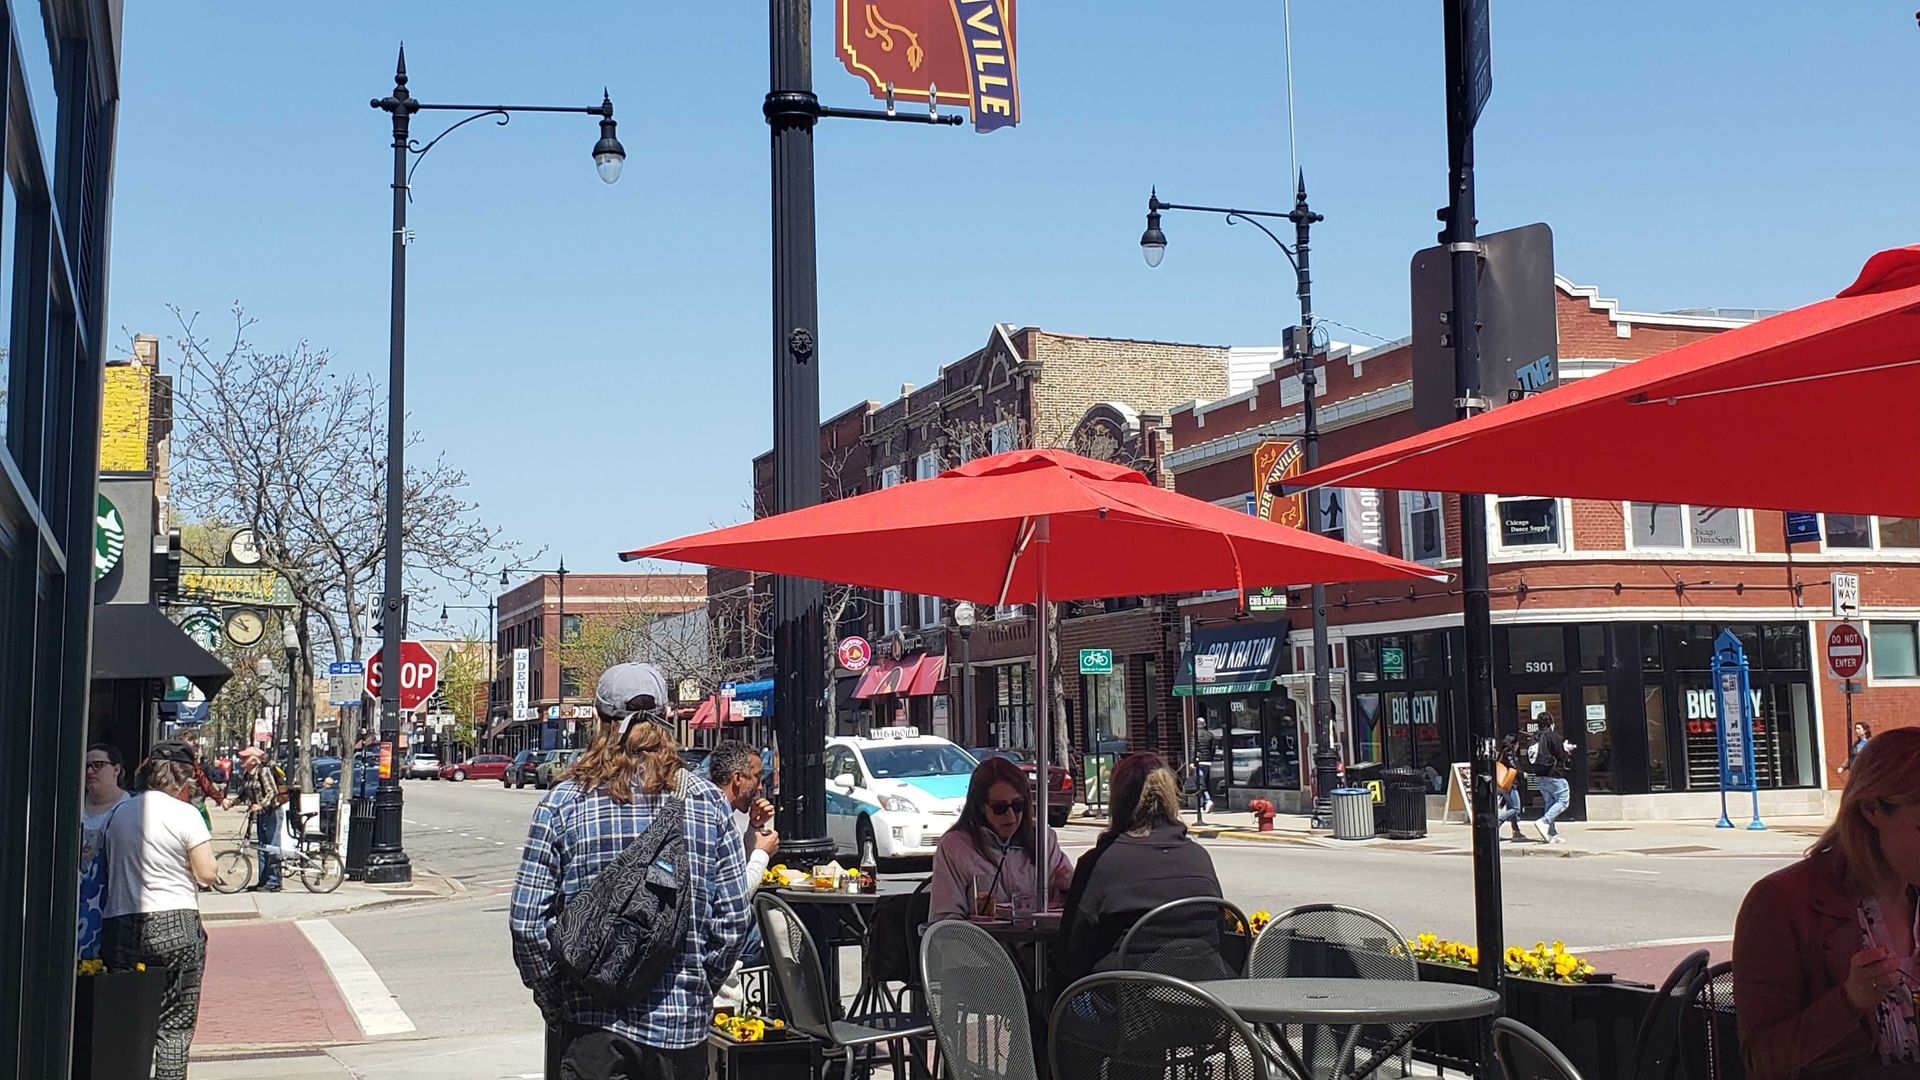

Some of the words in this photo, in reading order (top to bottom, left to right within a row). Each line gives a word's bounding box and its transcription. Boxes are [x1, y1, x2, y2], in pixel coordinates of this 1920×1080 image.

[961, 0, 1011, 117] VILLE
[1360, 488, 1380, 507] IG
[1361, 510, 1383, 547] CITY
[1529, 524, 1551, 533] Supply
[1838, 576, 1856, 589] ONE
[1248, 595, 1262, 606] CBD
[1262, 595, 1288, 605] KRATOM
[1838, 589, 1856, 601] WAY
[1831, 634, 1842, 644] DO
[1844, 634, 1859, 644] NOT
[1227, 636, 1276, 669] KRATOM
[1525, 661, 1554, 673] 5301
[1835, 658, 1857, 668] ENTER
[370, 662, 433, 689] SOP
[516, 661, 526, 719] DENTAL
[1230, 701, 1245, 712] OPEN
[1392, 697, 1410, 725] BIG
[1412, 695, 1438, 724] CITY
[1686, 689, 1717, 719] BIG
